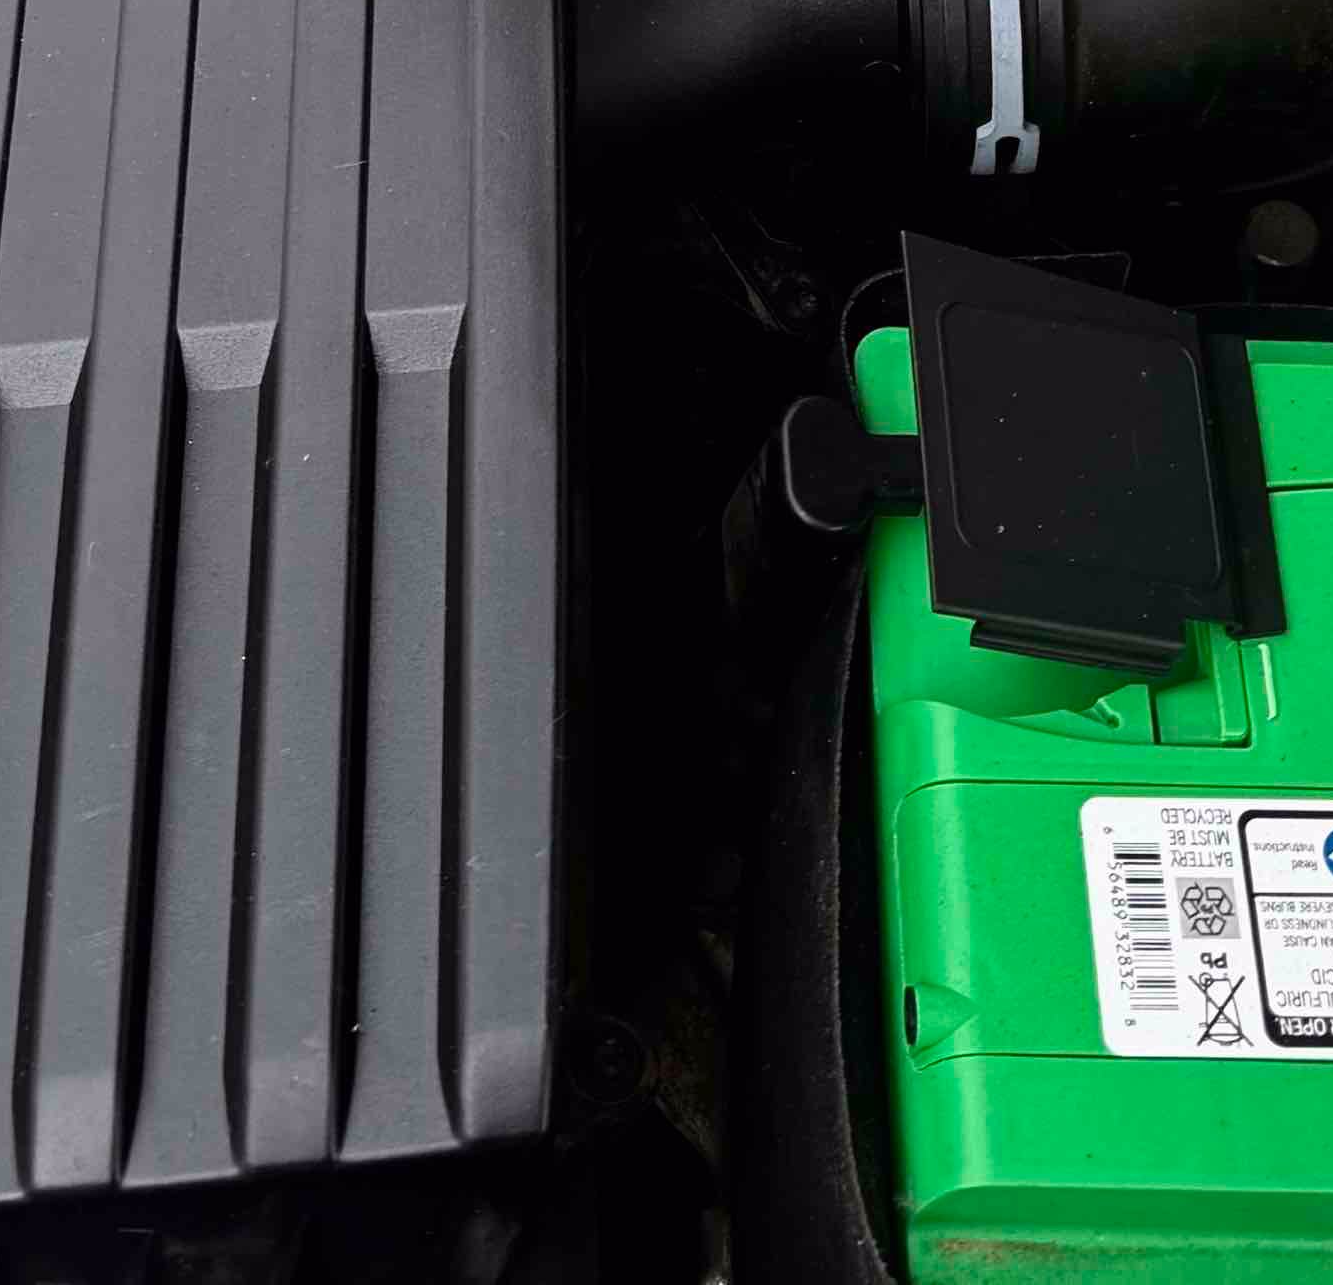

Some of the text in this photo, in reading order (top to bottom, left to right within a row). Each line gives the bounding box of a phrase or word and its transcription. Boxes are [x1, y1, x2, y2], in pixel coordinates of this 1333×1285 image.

[1160, 807, 1232, 824] RECYCLED
[1168, 829, 1230, 845] MUST BE
[1170, 849, 1233, 868] BATTERY
[1291, 859, 1318, 871] Read
[1264, 918, 1276, 929] OR
[1283, 936, 1316, 947] CAUSE
[1114, 930, 1133, 991] 32832
[1200, 952, 1228, 968] Pb
[1274, 1017, 1326, 1036] OPEN.
